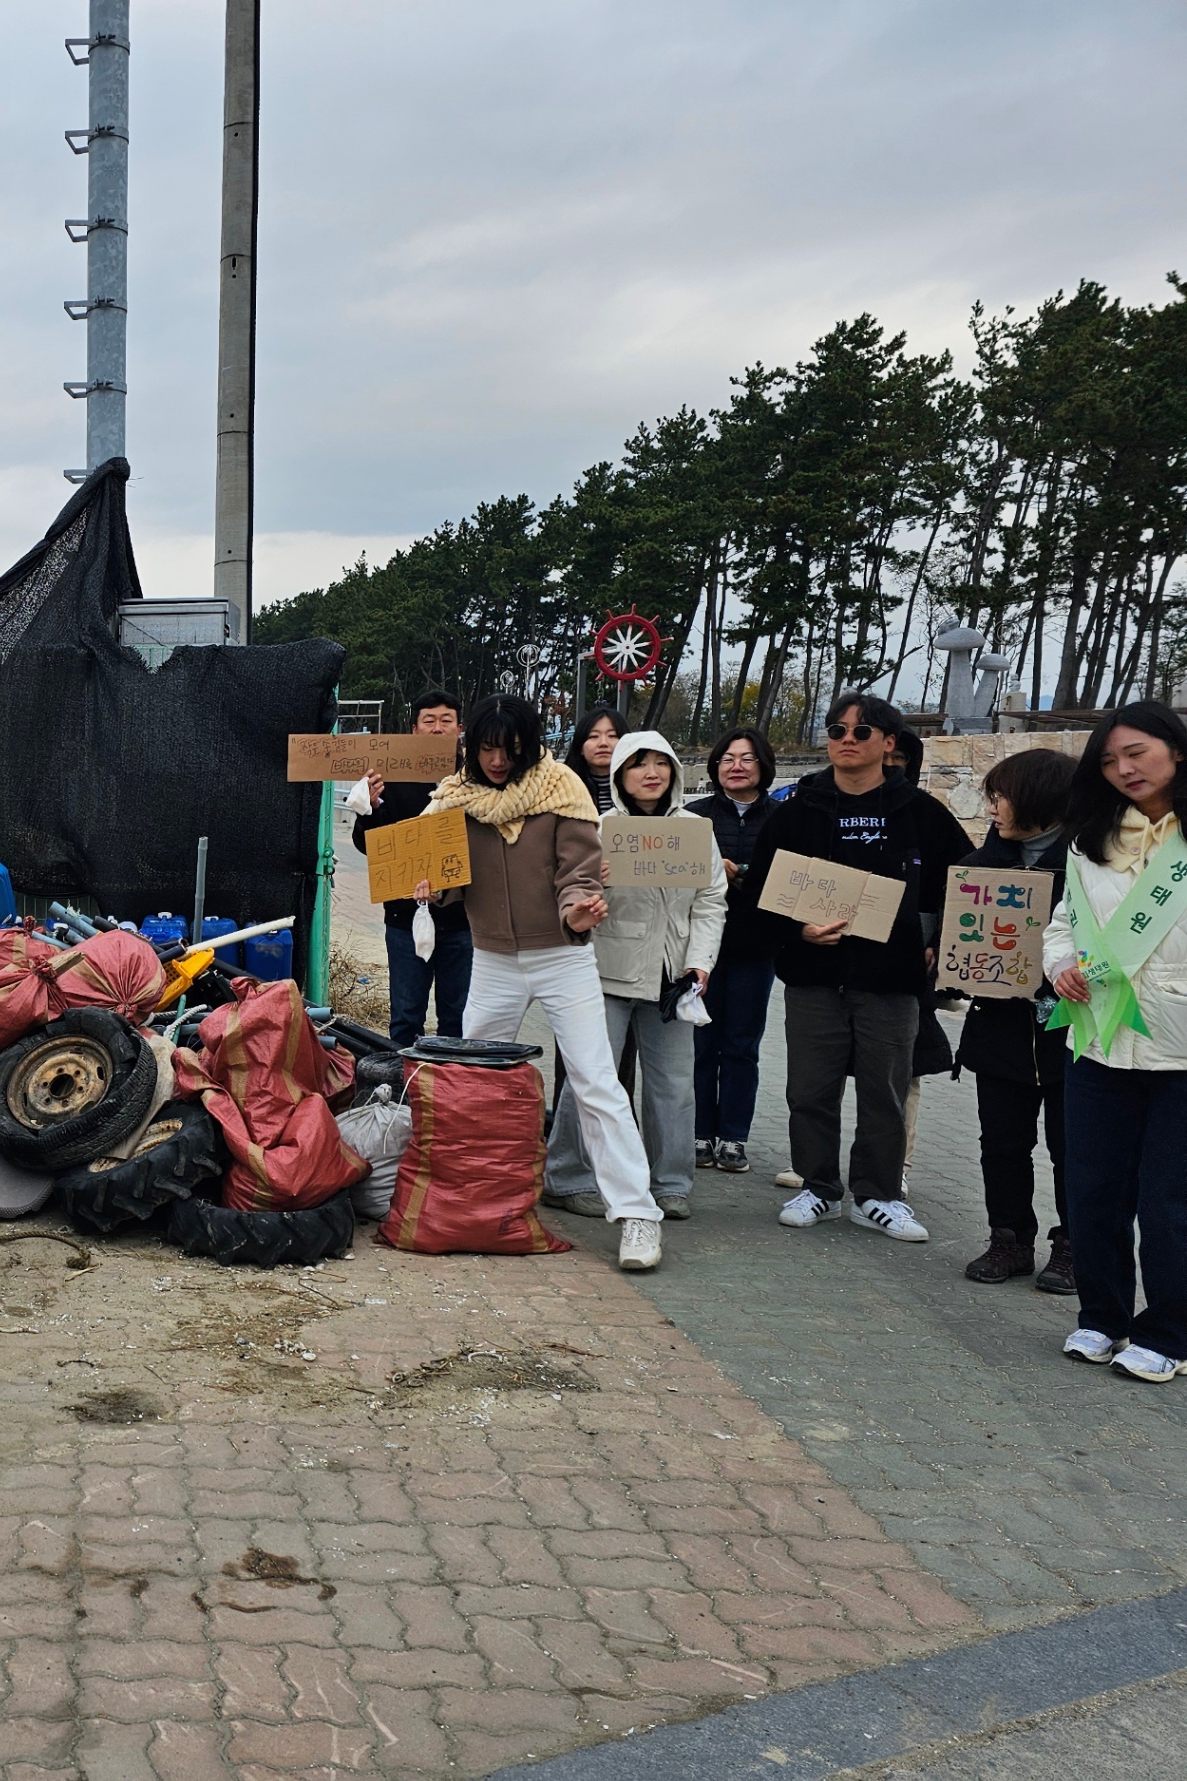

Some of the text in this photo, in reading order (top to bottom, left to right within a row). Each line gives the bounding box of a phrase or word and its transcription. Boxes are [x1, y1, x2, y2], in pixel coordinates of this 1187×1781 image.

[369, 739, 390, 750] 모여
[376, 816, 454, 860] 바다를
[375, 852, 432, 892] 지키자
[790, 870, 837, 898] 바다
[959, 883, 1033, 909] 가치
[958, 912, 1021, 950] 있는
[945, 944, 1033, 986] 협동조합
